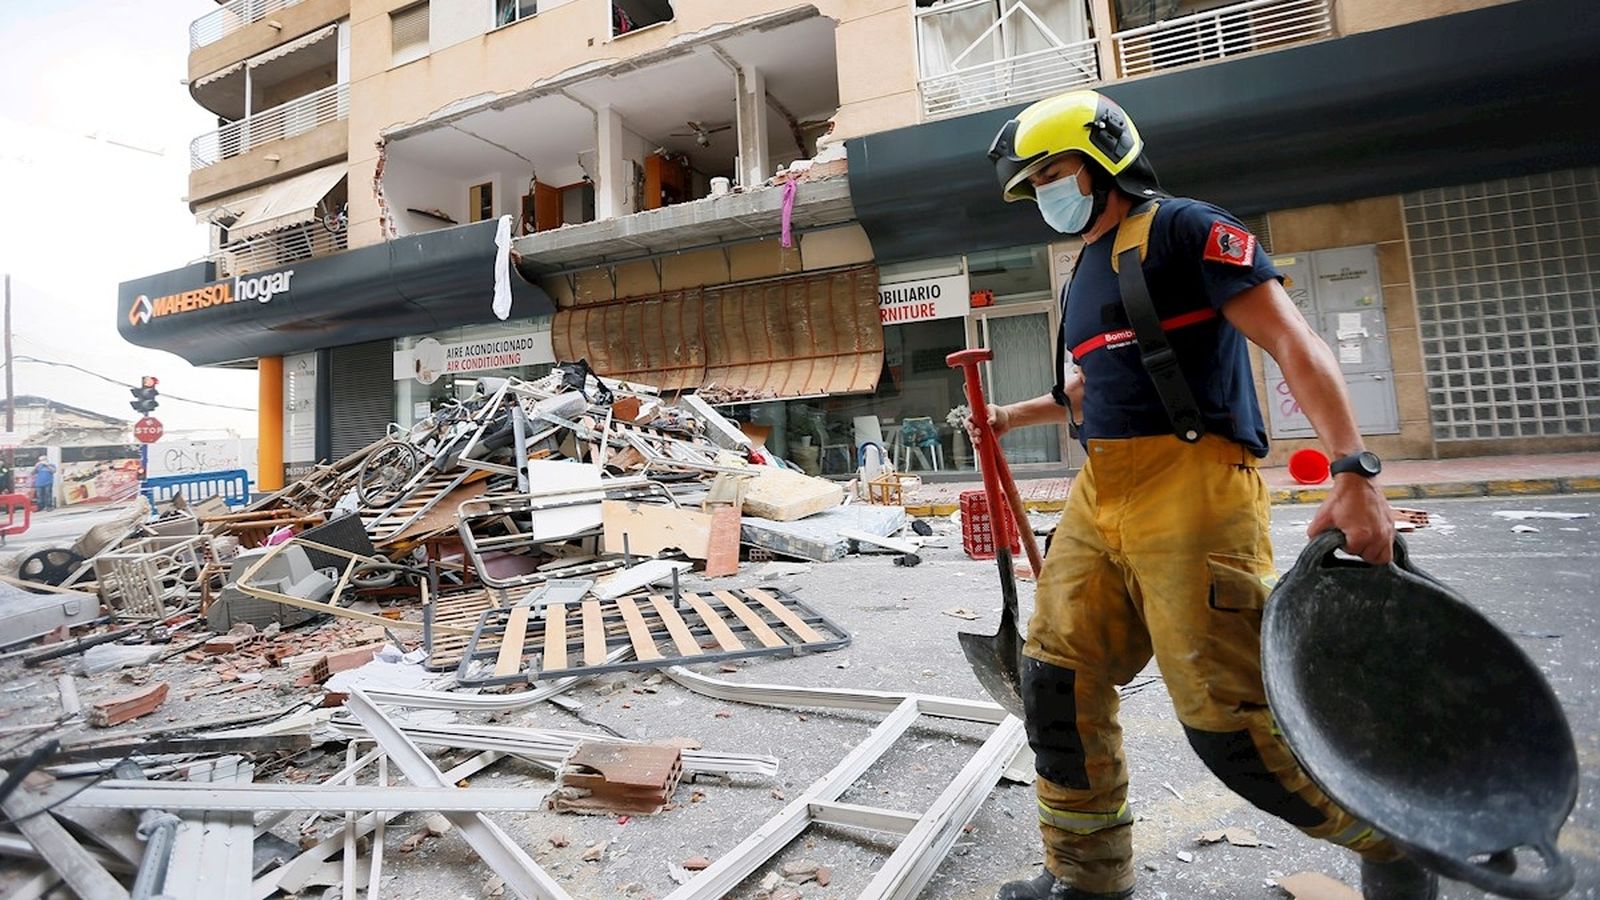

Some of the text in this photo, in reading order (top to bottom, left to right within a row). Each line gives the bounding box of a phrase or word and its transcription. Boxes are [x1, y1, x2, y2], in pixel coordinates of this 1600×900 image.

[447, 338, 533, 359] AIRE ACONDICIONADO
[447, 353, 521, 371] AIR CONDITIONING
[135, 426, 162, 434] STOP
